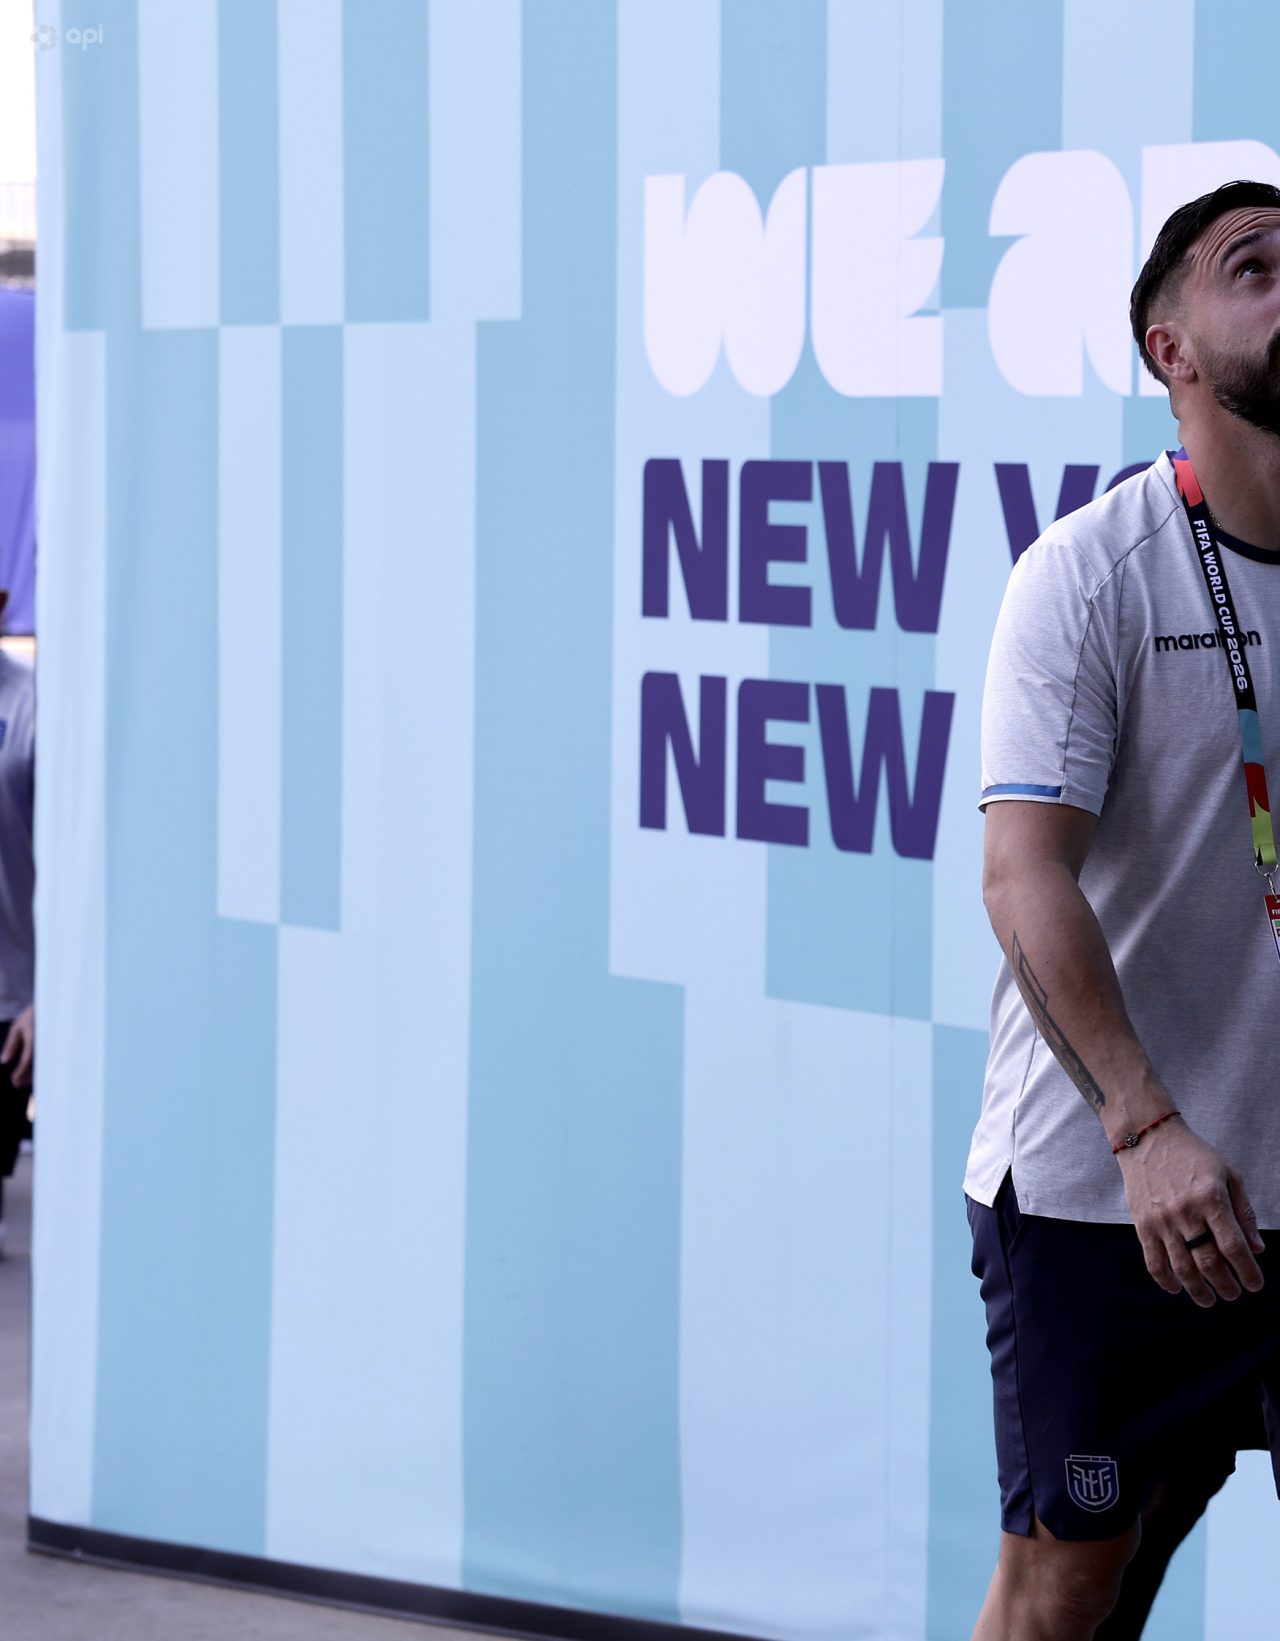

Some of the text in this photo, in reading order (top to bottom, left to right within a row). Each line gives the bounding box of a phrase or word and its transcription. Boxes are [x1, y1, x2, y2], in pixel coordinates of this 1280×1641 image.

[643, 158, 945, 398] WE
[642, 458, 960, 634] NEW
[1194, 519, 1248, 691] FIFA WORLD CUP 2026
[1154, 628, 1262, 652] maraton
[639, 671, 956, 861] NEW
